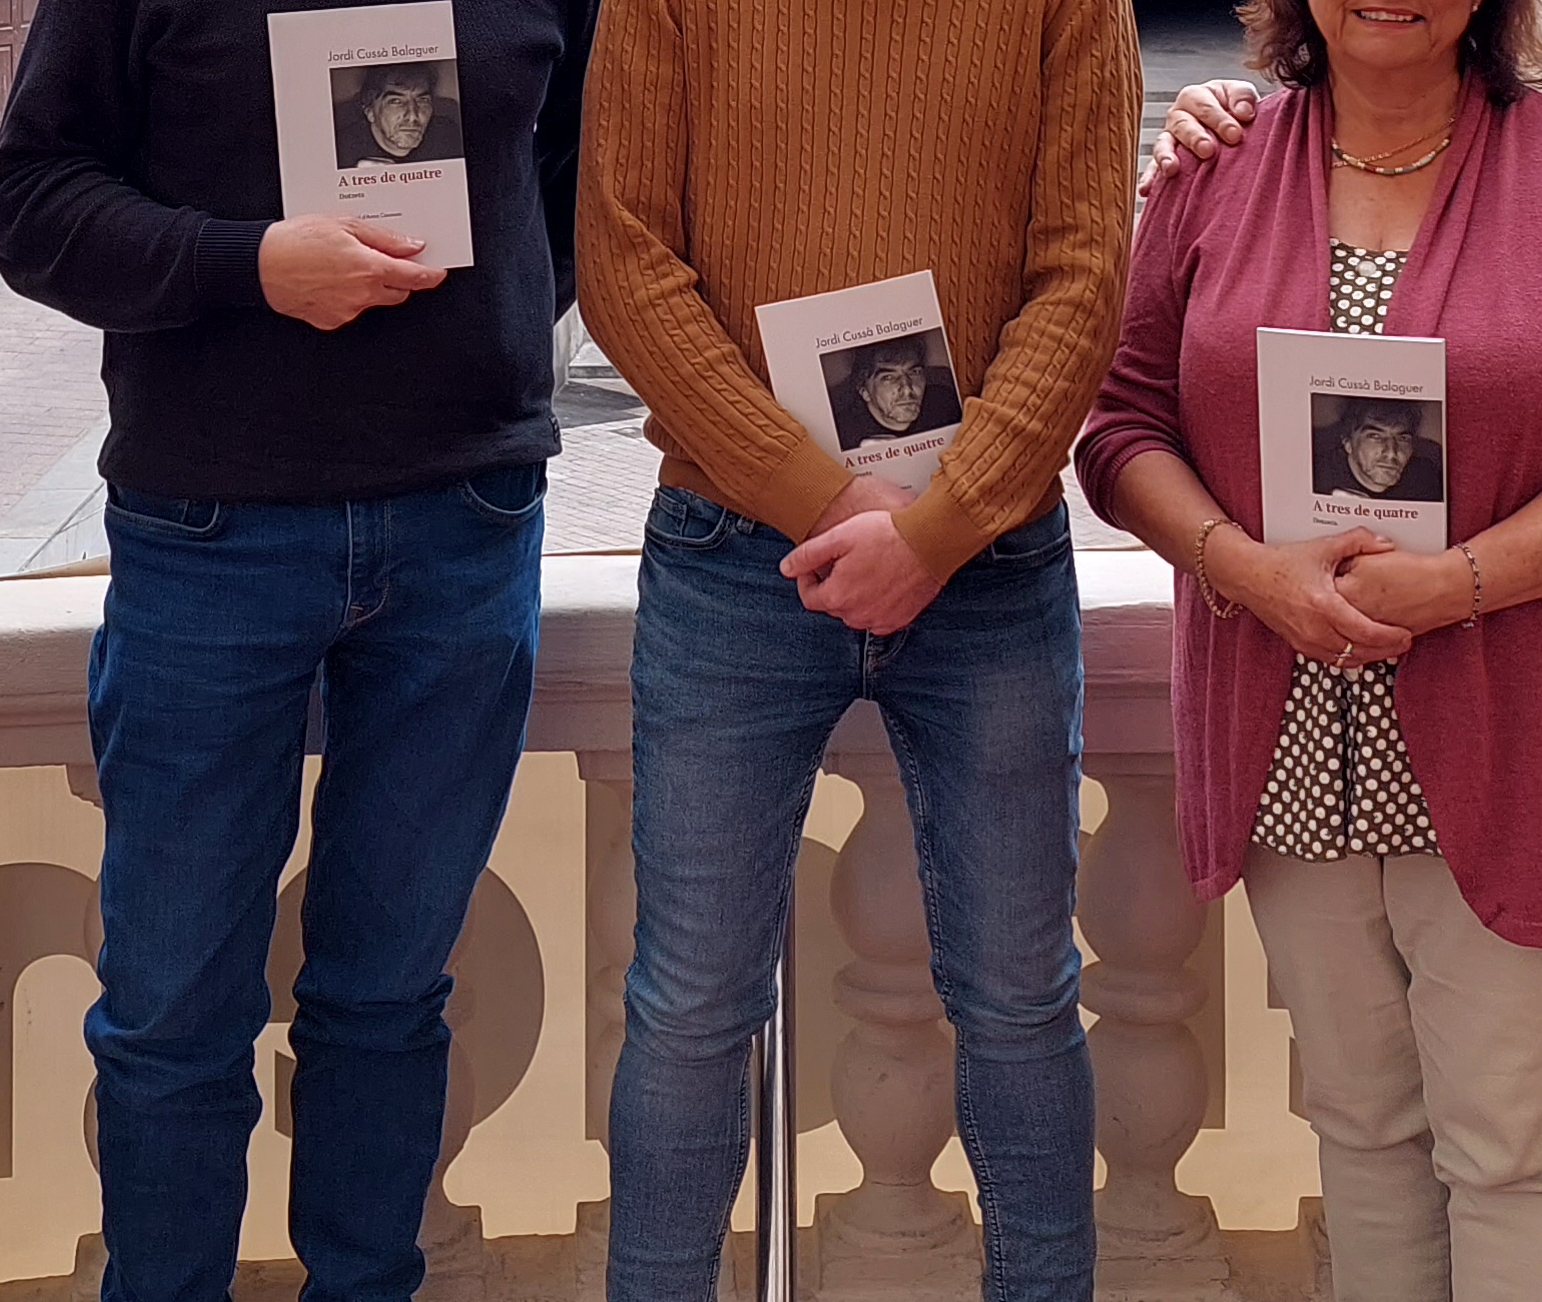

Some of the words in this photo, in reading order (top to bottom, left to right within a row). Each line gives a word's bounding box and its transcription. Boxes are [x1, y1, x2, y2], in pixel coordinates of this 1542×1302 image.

[327, 50, 354, 62] Jordi
[356, 47, 389, 59] Cussà
[391, 44, 439, 58] Balaguer
[338, 175, 349, 187] A
[352, 174, 377, 186] tres
[380, 170, 396, 183] de
[399, 168, 442, 187] quatre
[815, 333, 841, 348] Jordi
[842, 326, 874, 343] Cussà
[875, 317, 923, 335] Balaguer
[1309, 375, 1335, 388] Jordi
[1338, 377, 1371, 390] Cussà
[1373, 380, 1424, 396] Balaguer
[844, 457, 855, 469] A
[857, 451, 883, 465] tres
[885, 447, 900, 459] de
[902, 435, 945, 457] quatre
[1313, 500, 1323, 512] A
[1326, 502, 1351, 515] tres
[1354, 504, 1370, 517] de
[1373, 506, 1419, 520] quatre
